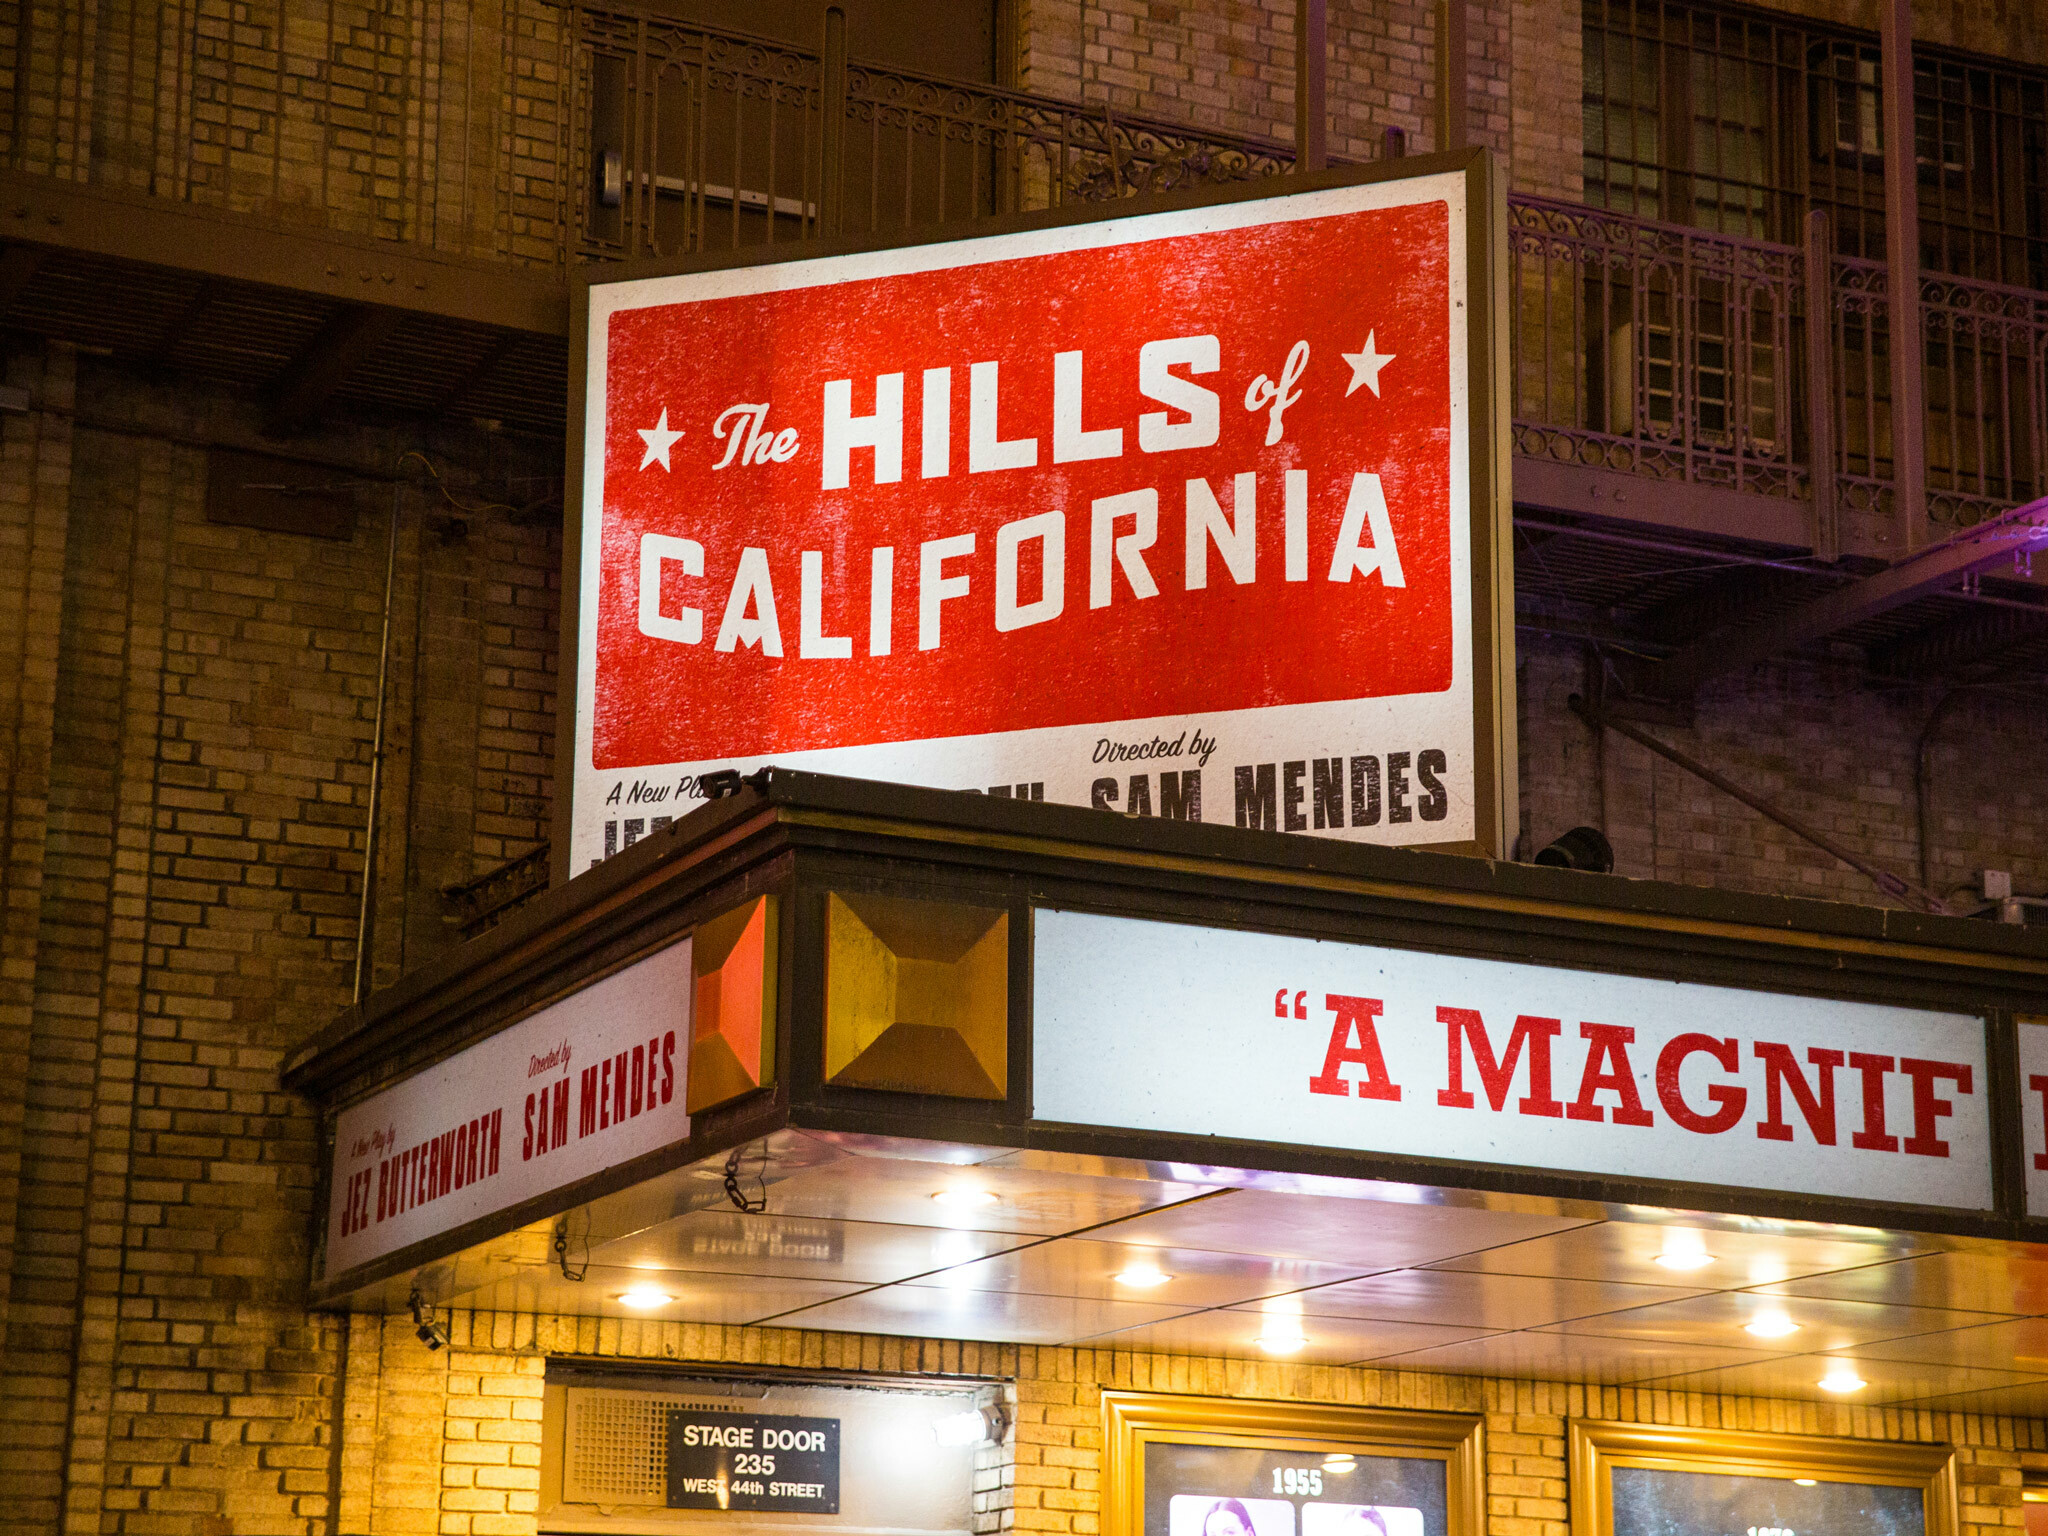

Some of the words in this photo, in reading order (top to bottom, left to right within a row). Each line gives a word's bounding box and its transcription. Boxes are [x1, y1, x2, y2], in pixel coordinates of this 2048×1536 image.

[712, 402, 800, 470] The
[822, 334, 1220, 491] HILLS
[1244, 340, 1310, 446] of
[638, 469, 1406, 660] CALIFORNIA
[1092, 732, 1185, 764] Directed
[1188, 728, 1217, 768] by
[605, 781, 622, 806] A
[626, 780, 671, 804] New
[675, 775, 706, 801] Pl
[1234, 748, 1448, 833] MENDES
[528, 1041, 562, 1078] Directed
[1436, 1005, 1973, 1158] MAGNIF
[341, 1168, 373, 1238] JEZ
[377, 1107, 503, 1223] BUTTERWORTH
[522, 1076, 571, 1162] SAM
[579, 1030, 676, 1140] MENDES
[683, 1425, 754, 1448] STAGE
[762, 1429, 826, 1452] DOOR
[734, 1453, 776, 1476] 235
[1272, 1467, 1323, 1496] 1955
[683, 1478, 726, 1494] WEST
[731, 1480, 764, 1495] 44th
[769, 1481, 825, 1498] STREET
